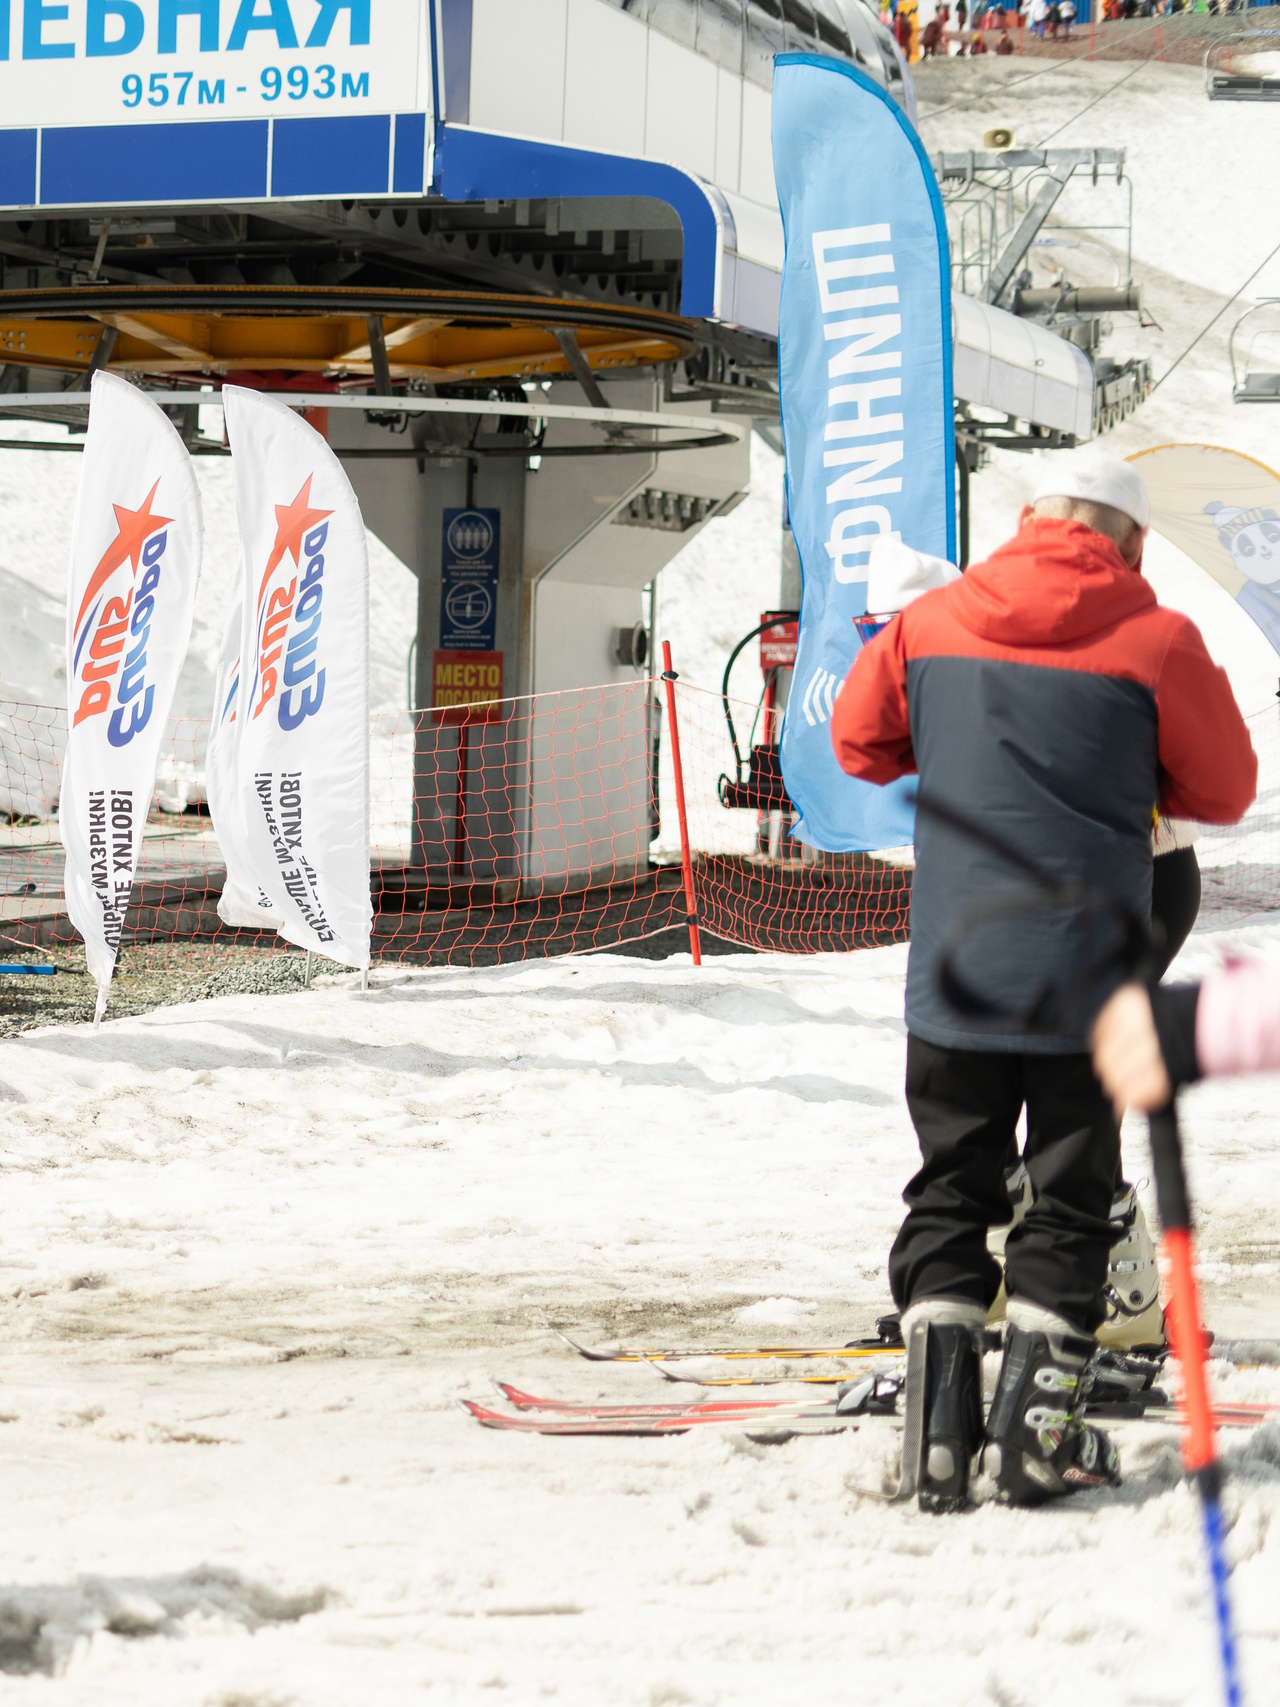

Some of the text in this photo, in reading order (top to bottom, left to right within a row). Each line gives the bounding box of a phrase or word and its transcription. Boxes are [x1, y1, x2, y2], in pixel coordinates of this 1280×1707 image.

[121, 70, 226, 108] 957м
[260, 63, 371, 102] 993м
[435, 664, 500, 688] МЕСТО
[435, 689, 499, 714] ПОСАДКИ
